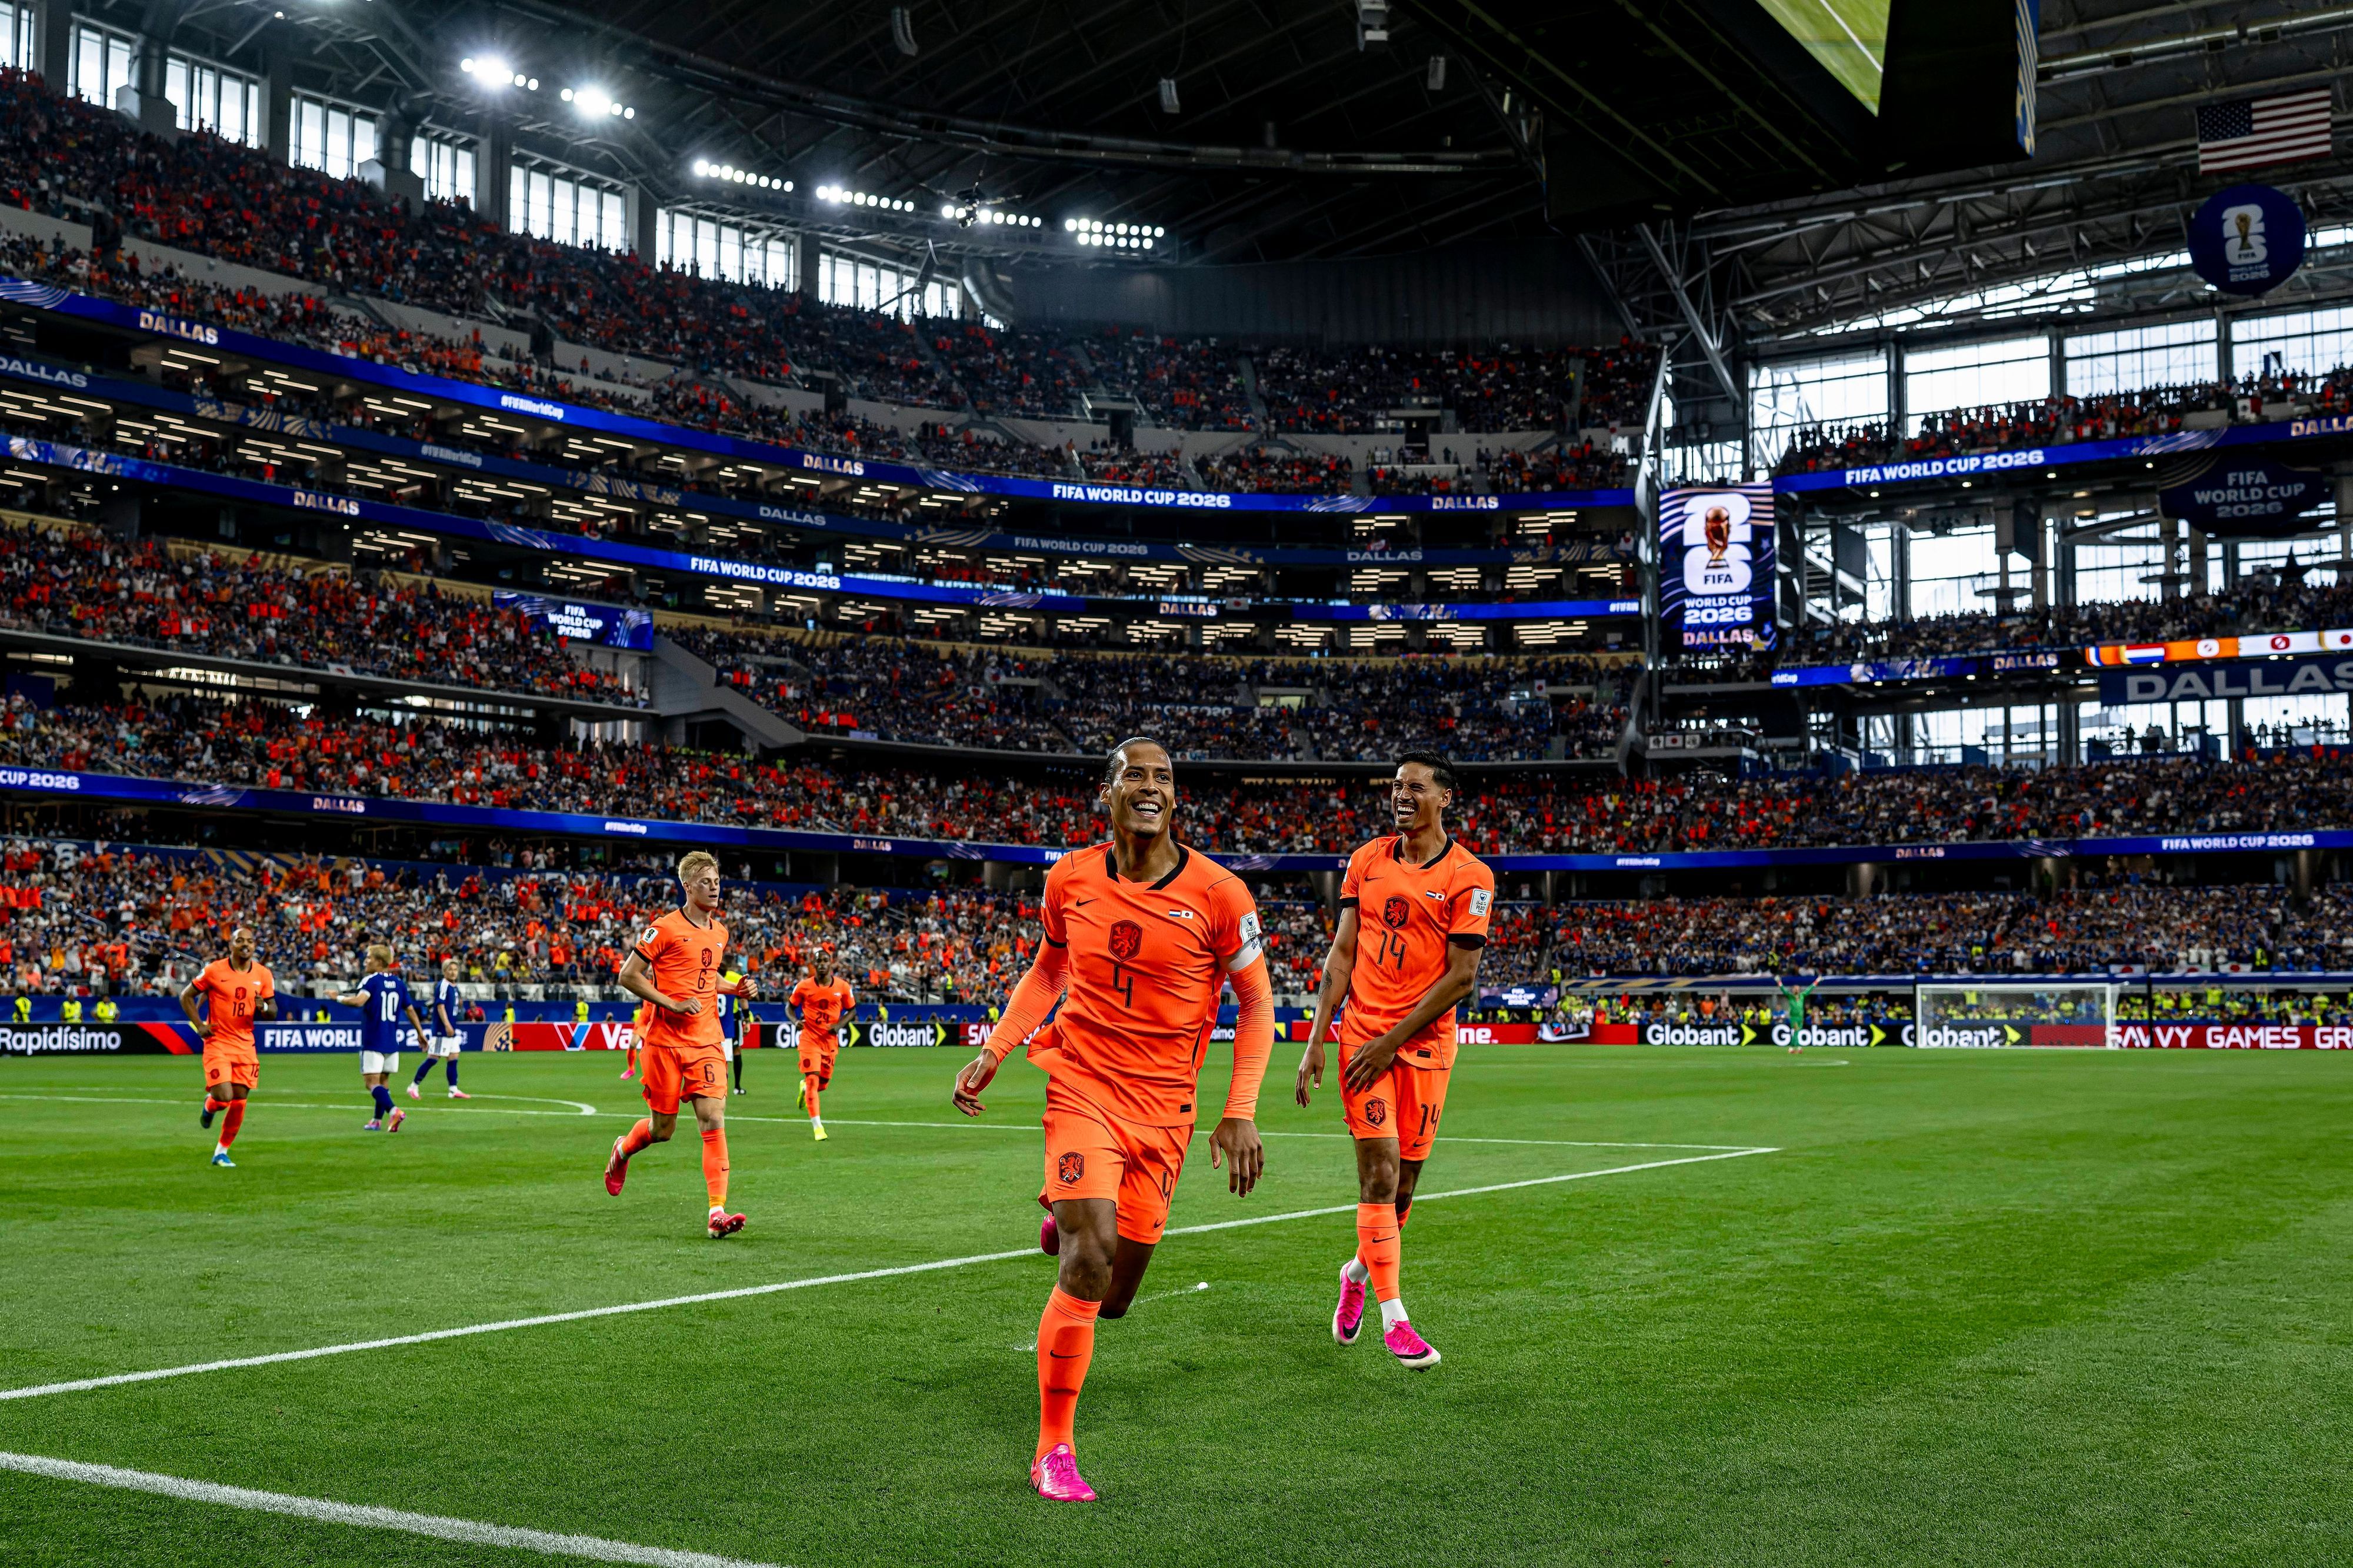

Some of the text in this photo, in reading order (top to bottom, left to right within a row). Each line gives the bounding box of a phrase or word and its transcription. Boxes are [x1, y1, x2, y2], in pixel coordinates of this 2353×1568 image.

[139, 311, 219, 345] DALLAS
[0, 355, 88, 388] ALLAS
[803, 453, 865, 476] DALLAS
[1845, 449, 2045, 485] FIFA WORLD CUP 2026
[2227, 470, 2268, 487] FIFA
[294, 491, 360, 516] DALLAS
[1052, 483, 1231, 508] FIFA WORLD CUP 2026
[1432, 496, 1499, 510] DALLAS
[2194, 482, 2306, 505] WORLD CUP
[759, 505, 826, 526] DALLAS
[2216, 501, 2284, 519] 2026
[1014, 536, 1148, 555] FIFA WORLD CUP 2026
[1347, 550, 1424, 562] DALLAS
[691, 556, 841, 589] FIFA WORLD CUP 2026
[1703, 572, 1734, 585] FIFA
[564, 605, 587, 618] FIFA
[1159, 602, 1218, 617] DALLAS
[1684, 594, 1753, 609] WORLD CUP
[547, 614, 604, 630] WORLD CUP
[1684, 606, 1754, 625] 2026
[557, 625, 592, 639] 2026
[1682, 628, 1755, 646] DALLAS
[1993, 652, 2058, 670] DALLAS
[0, 770, 81, 790] CUP 2026
[313, 796, 365, 814] DALLAS
[853, 839, 892, 852] DALLAS
[2161, 833, 2315, 850] FIFA WORLD CUP 2026
[1895, 847, 1945, 859] DALLAS
[1377, 930, 1407, 970] 14
[698, 968, 708, 990] 6
[1113, 963, 1134, 1009] 4
[232, 1001, 246, 1017] 18
[381, 990, 399, 1022] 10
[815, 1011, 829, 1025] 24
[0, 1026, 122, 1056] Rapidísimo
[264, 1029, 305, 1047] FIFA
[869, 1022, 935, 1047] Globant
[1647, 1023, 1739, 1046] Globant
[1771, 1023, 1869, 1047] Gobant
[2105, 1026, 2193, 1049] SAVVY
[2206, 1026, 2301, 1050] GAMES
[704, 1063, 715, 1083] 6
[1418, 1103, 1441, 1137] 14
[1162, 1170, 1174, 1210] 4
